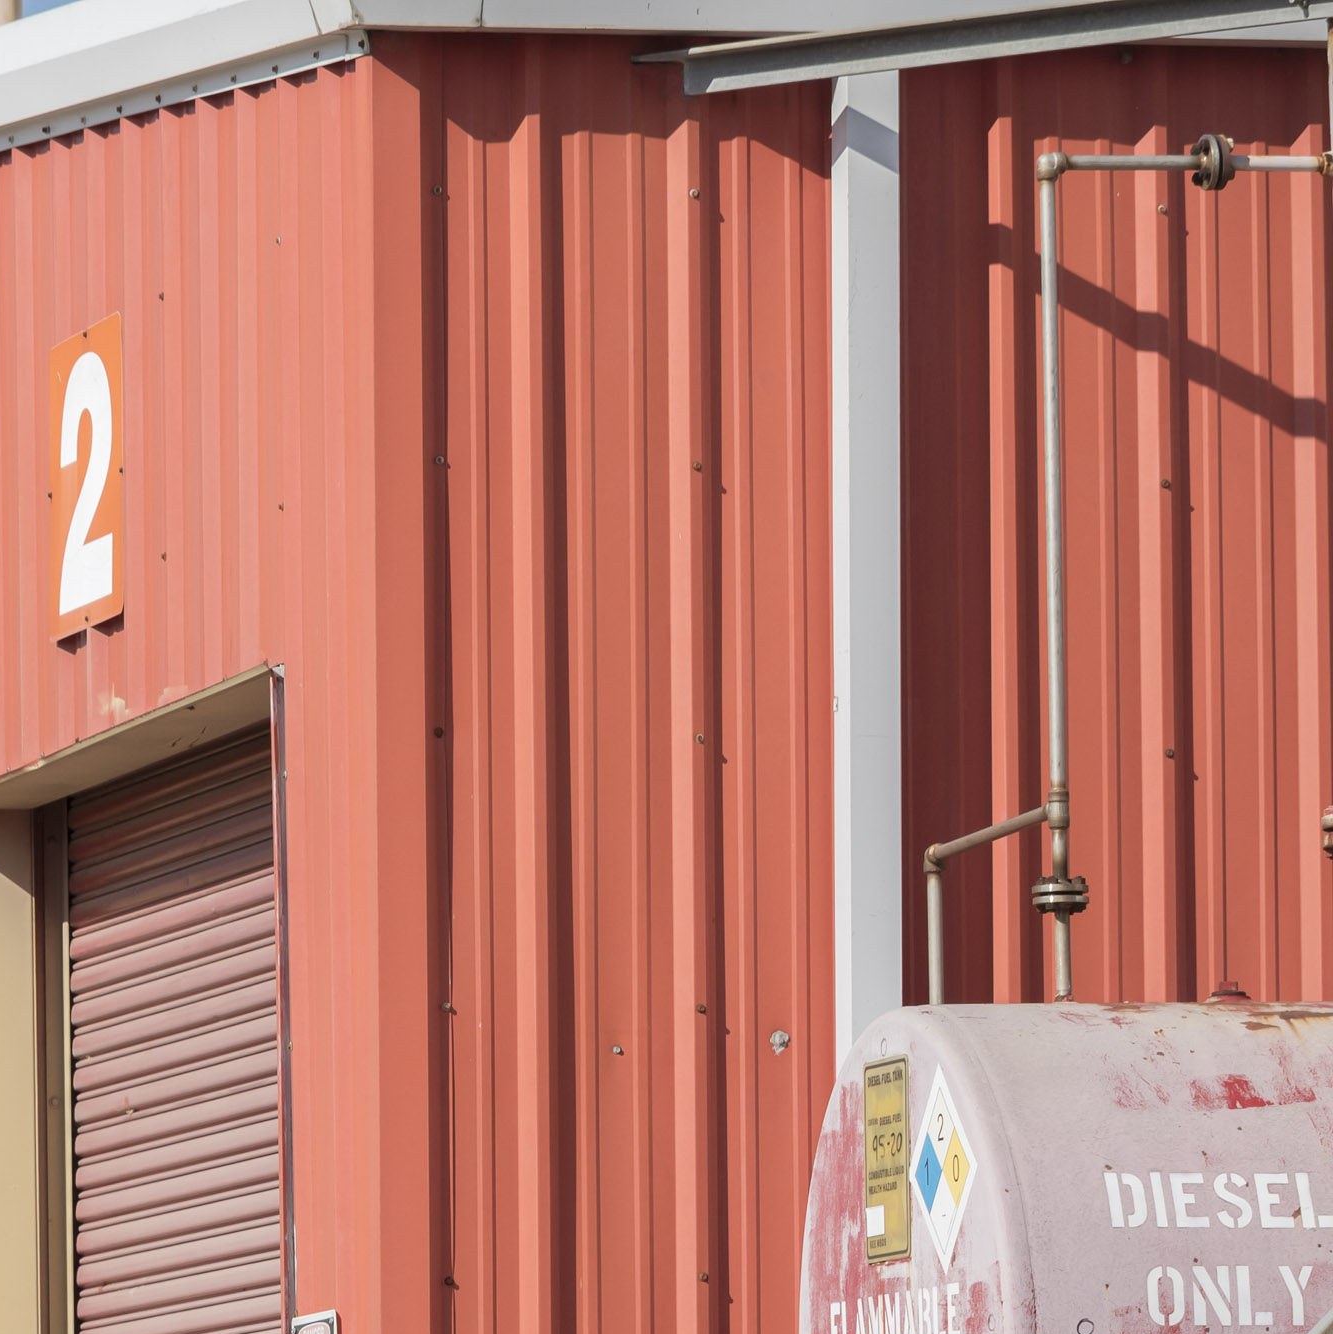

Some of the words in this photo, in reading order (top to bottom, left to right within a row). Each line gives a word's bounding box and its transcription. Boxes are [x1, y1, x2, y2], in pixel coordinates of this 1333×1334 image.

[59, 352, 113, 616] 2
[867, 1074, 881, 1088] DIESEL
[881, 1071, 892, 1085] FUEL
[892, 1068, 903, 1082] TANK
[937, 1113, 944, 1141] 2
[872, 1131, 903, 1161] 95-20
[868, 1167, 892, 1181] COMBUSTIBLE
[892, 1165, 905, 1176] LIQUID
[924, 1157, 929, 1185] 1
[952, 1154, 960, 1182] 0
[868, 1184, 882, 1195] HEALTH
[883, 1181, 897, 1192] HAZARD
[1103, 1171, 1333, 1229] DIESEL
[1147, 1265, 1313, 1326] ONLY
